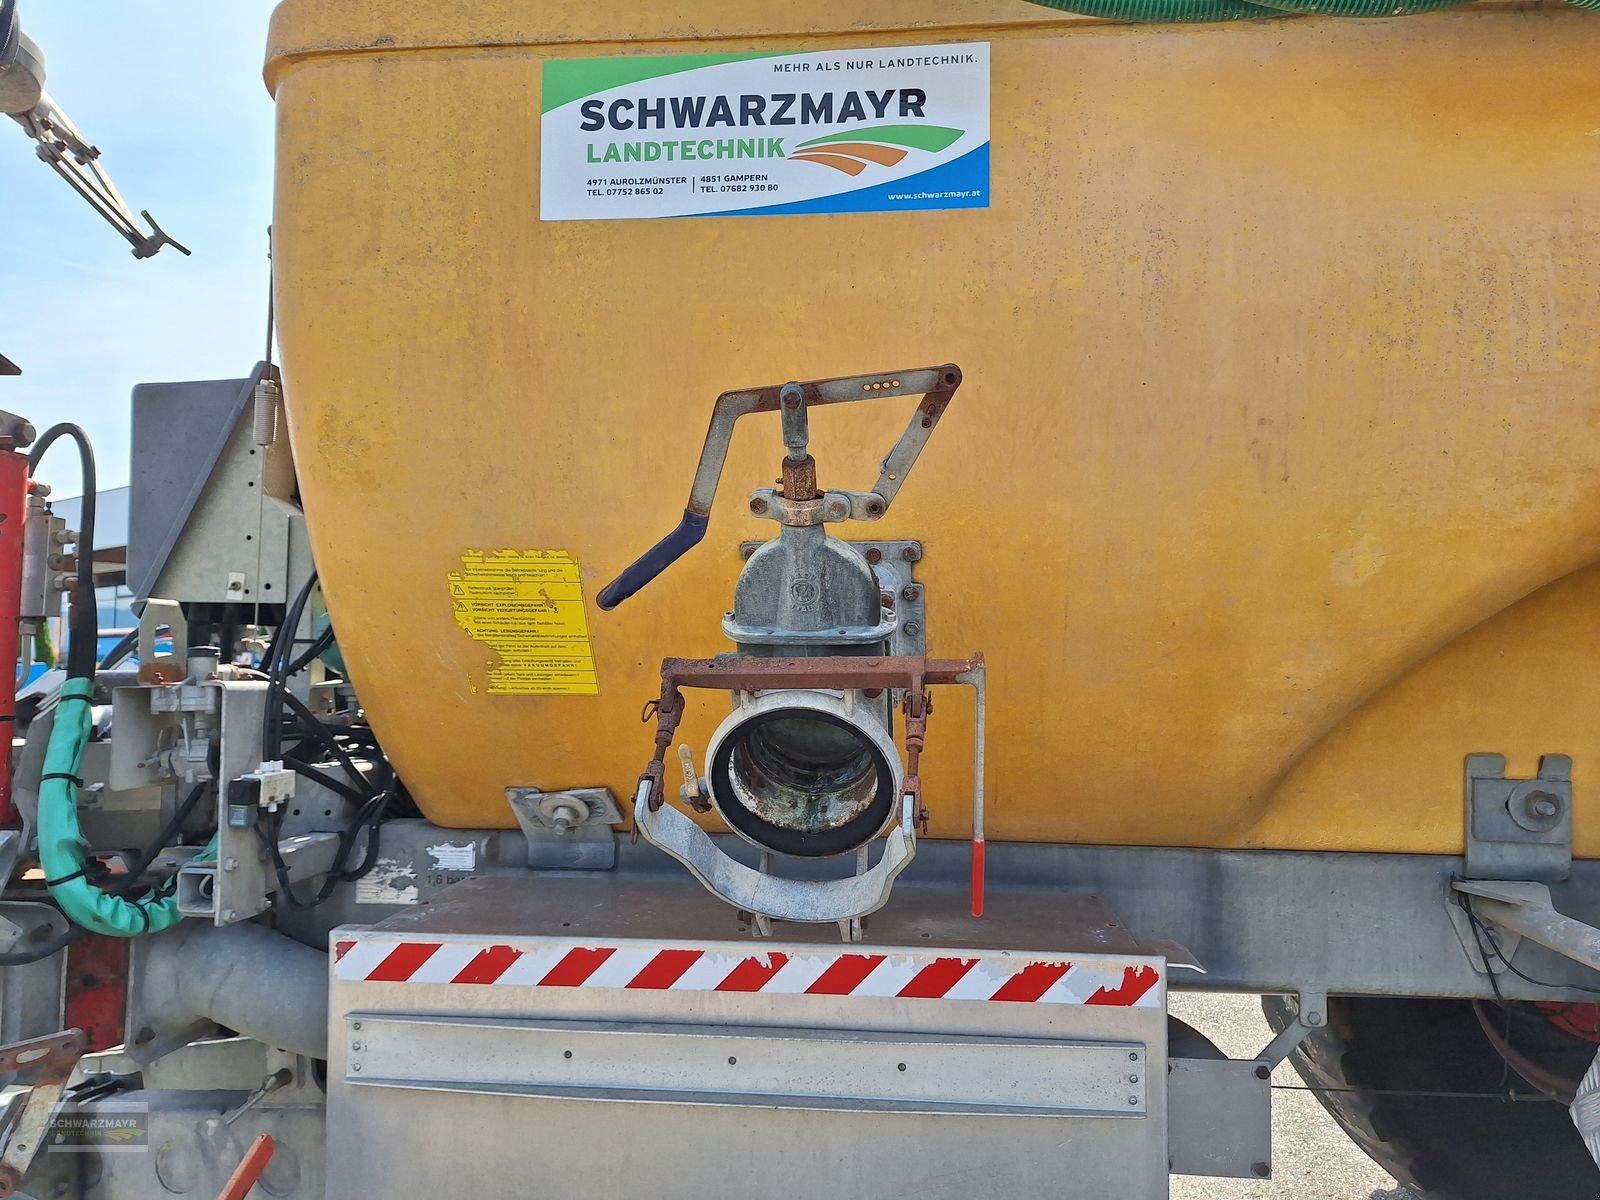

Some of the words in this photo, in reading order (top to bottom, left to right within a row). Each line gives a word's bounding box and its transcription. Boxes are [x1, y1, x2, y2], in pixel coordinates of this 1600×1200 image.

[774, 63, 810, 72] MEHR
[816, 61, 841, 71] ALS
[846, 60, 874, 70] NUR
[879, 54, 978, 68] LANDTECHNIK.
[579, 88, 927, 132] SCHWARZMAYR
[586, 137, 785, 163] LANDTECHNIK
[610, 176, 687, 186] AUROLZMÜNSTER
[700, 175, 721, 183] 4851
[723, 174, 768, 182] GAMPERN
[606, 188, 633, 196] 07752
[652, 187, 664, 195] 02
[720, 185, 747, 193] 07682
[749, 184, 766, 192] 930
[887, 189, 981, 201] www.schwarzmayr.at
